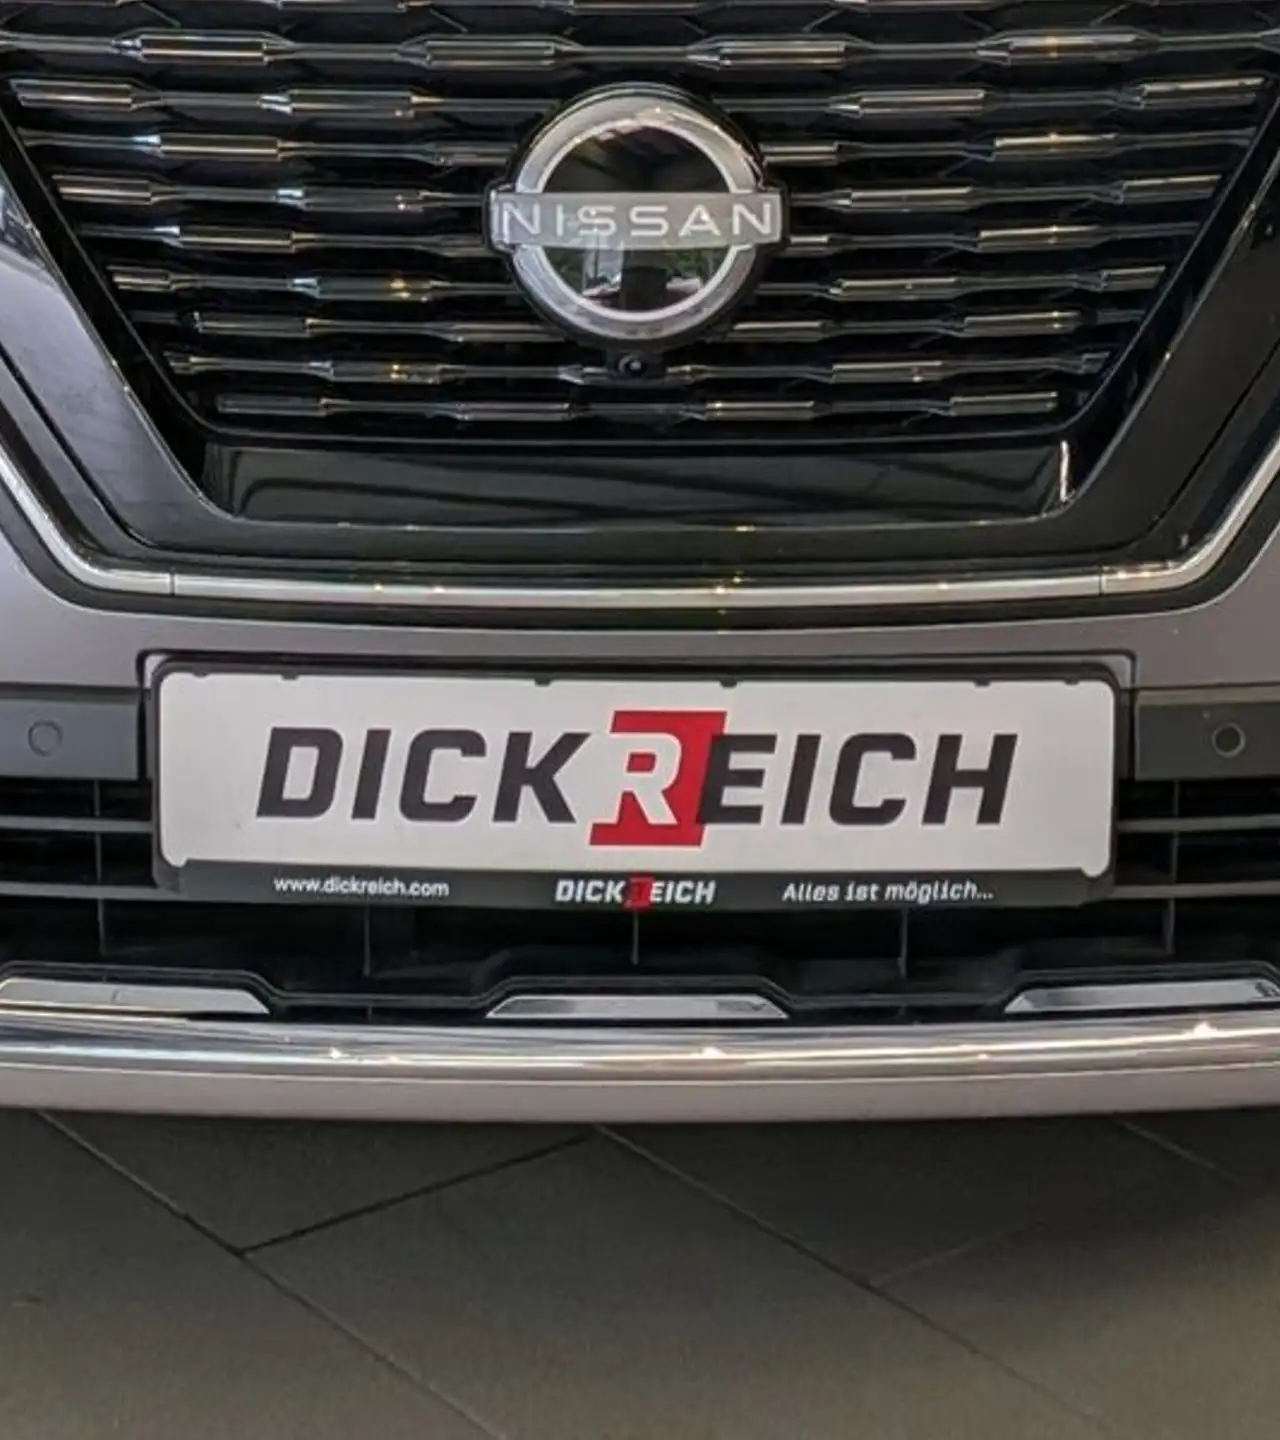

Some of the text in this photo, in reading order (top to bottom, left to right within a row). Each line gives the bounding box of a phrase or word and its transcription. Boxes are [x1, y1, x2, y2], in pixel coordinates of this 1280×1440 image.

[503, 201, 773, 237] NISSAN
[255, 722, 1018, 828] DICKREICH
[272, 875, 451, 897] www.dickreich.com
[781, 880, 840, 902] Alles
[843, 880, 880, 901] ist
